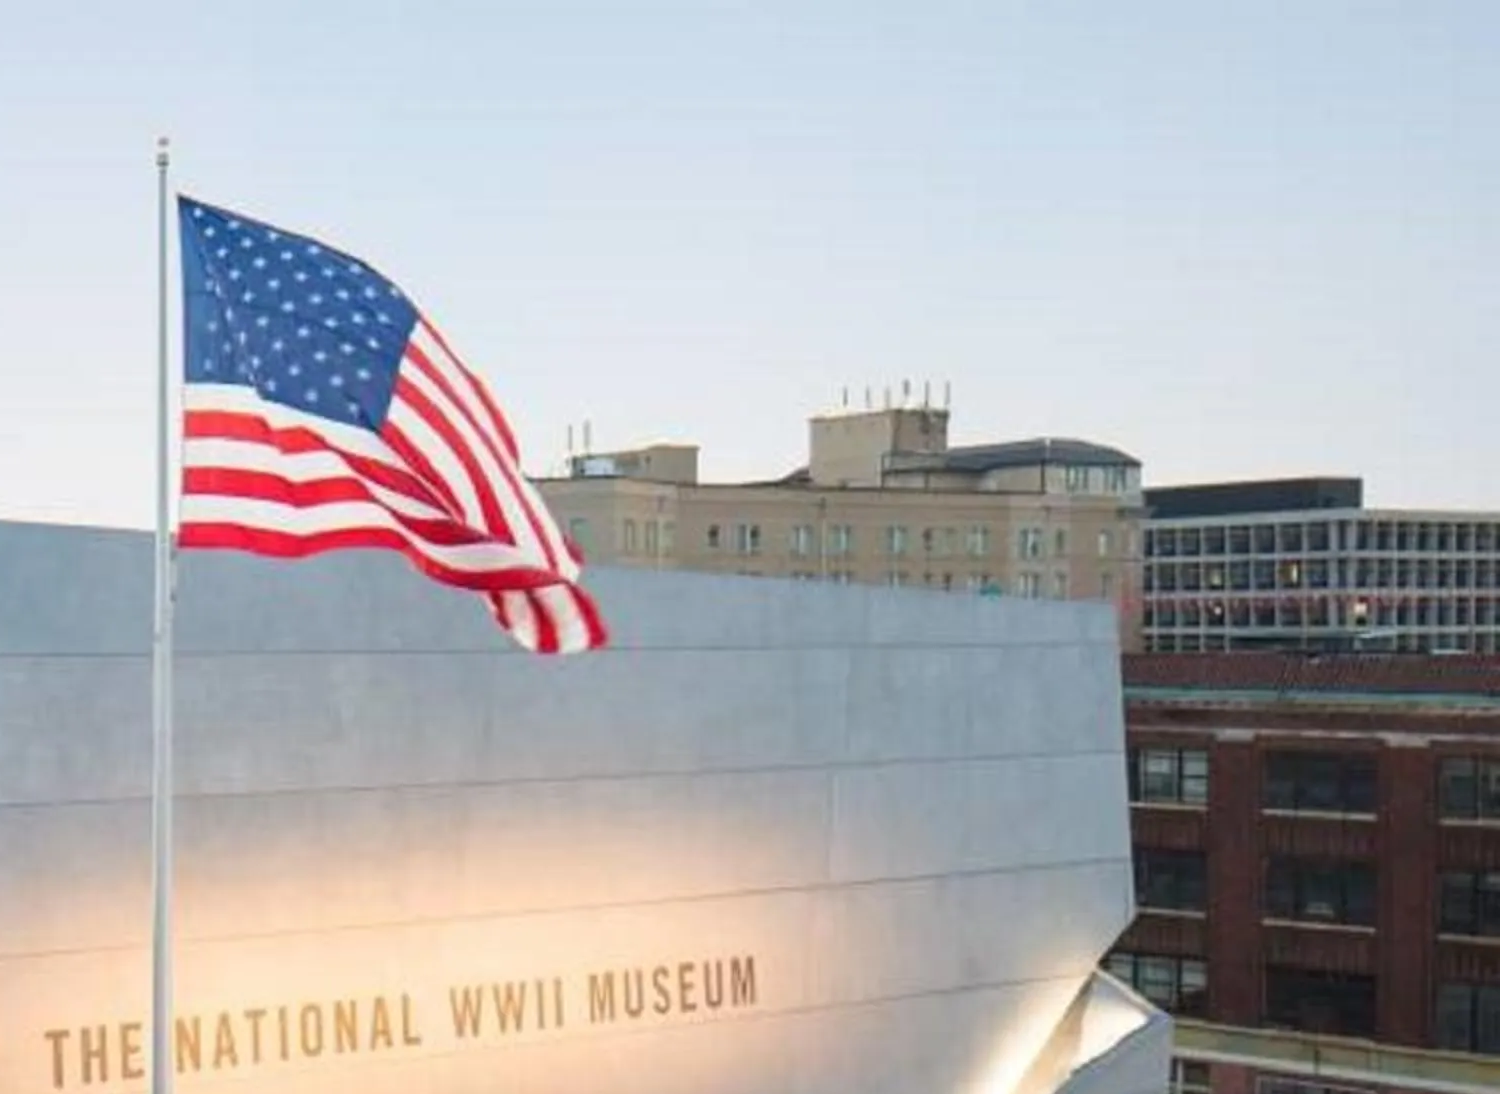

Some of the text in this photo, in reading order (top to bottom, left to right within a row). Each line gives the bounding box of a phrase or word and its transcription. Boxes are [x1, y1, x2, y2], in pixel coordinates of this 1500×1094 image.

[44, 955, 758, 1090] THE NATIONAL WWII MUSEUM
